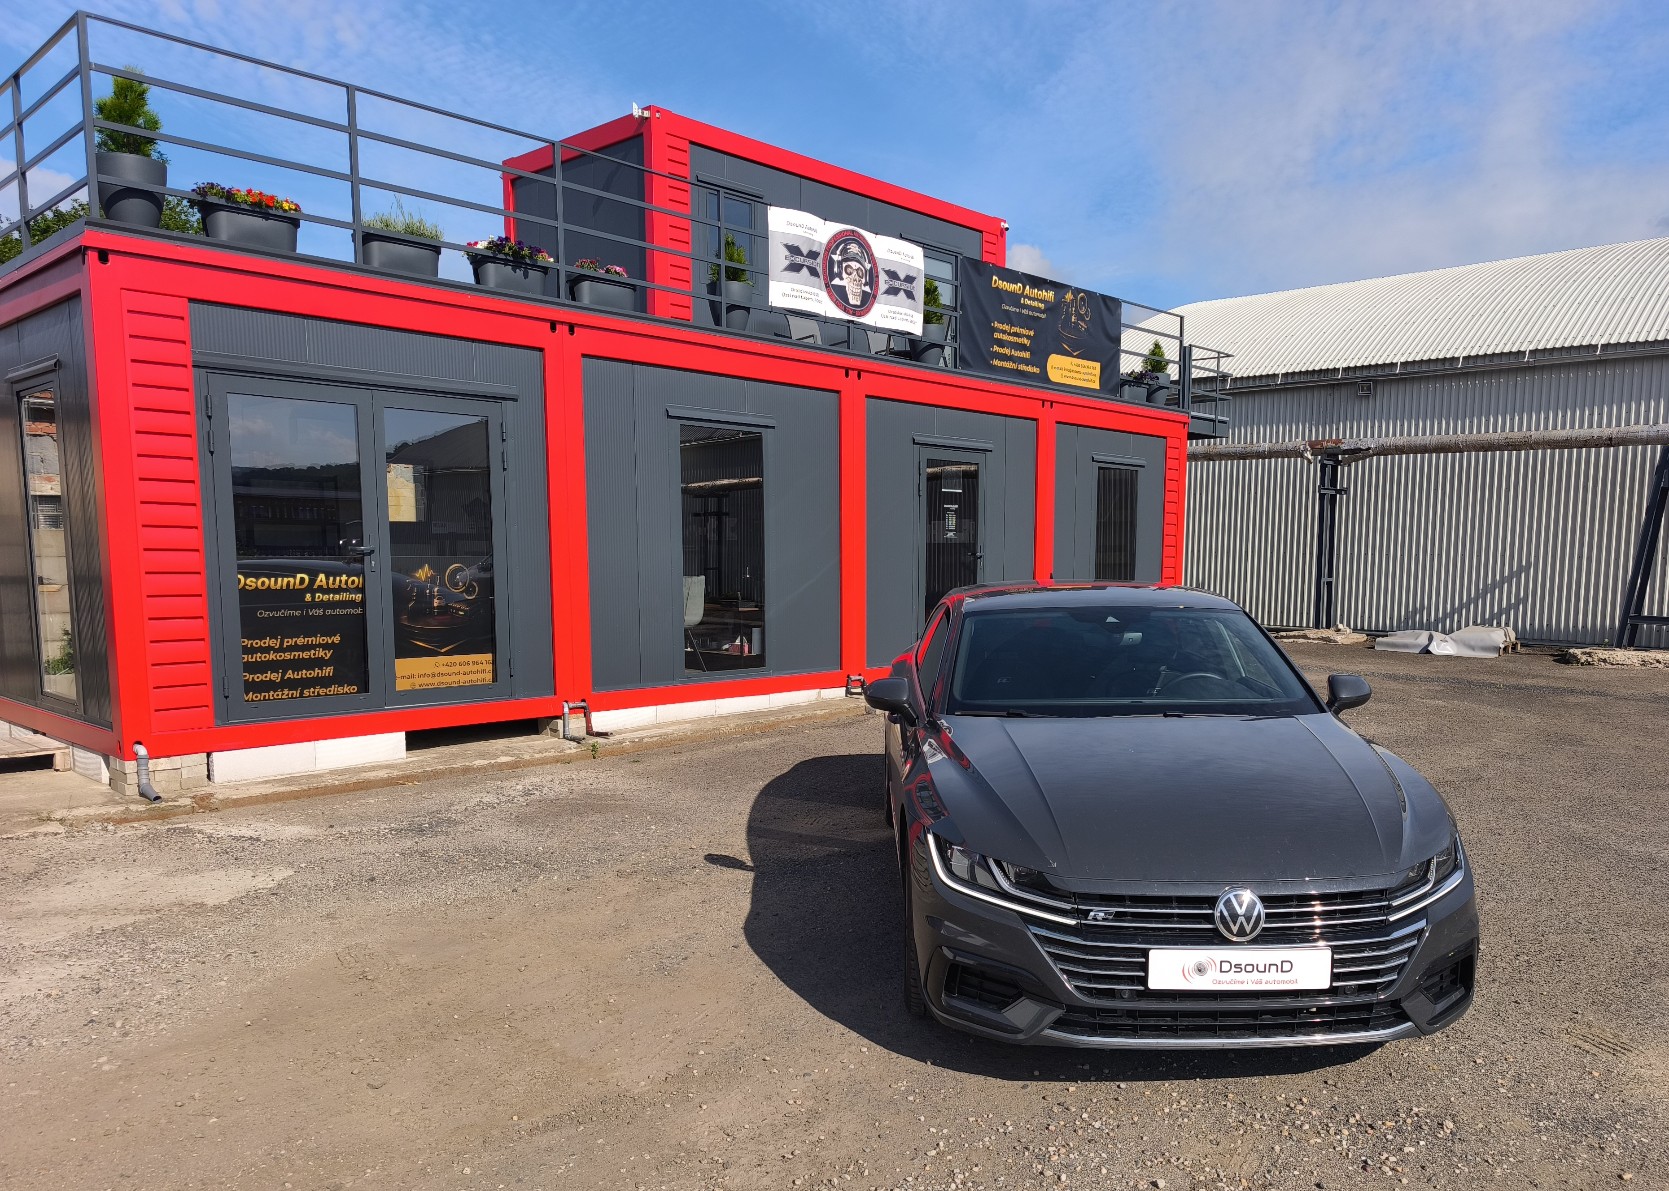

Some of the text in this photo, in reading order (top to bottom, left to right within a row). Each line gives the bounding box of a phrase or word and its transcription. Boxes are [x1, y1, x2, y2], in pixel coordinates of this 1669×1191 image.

[992, 275, 1054, 302] DsounD Autohifi
[1024, 298, 1044, 310] Detailing
[994, 321, 1010, 332] Prodej
[994, 332, 1030, 346] autokosmetiky
[993, 345, 1010, 356] Prodej
[305, 592, 362, 602] & Detailing
[257, 608, 300, 618] Ozvučíme
[308, 608, 324, 616] Váš
[241, 634, 341, 648] Prodej prémiové
[242, 648, 333, 662] autokosmetiky
[284, 666, 334, 680] Autohifi
[244, 684, 358, 702] Montážní středisko
[1219, 960, 1294, 974] DsounD
